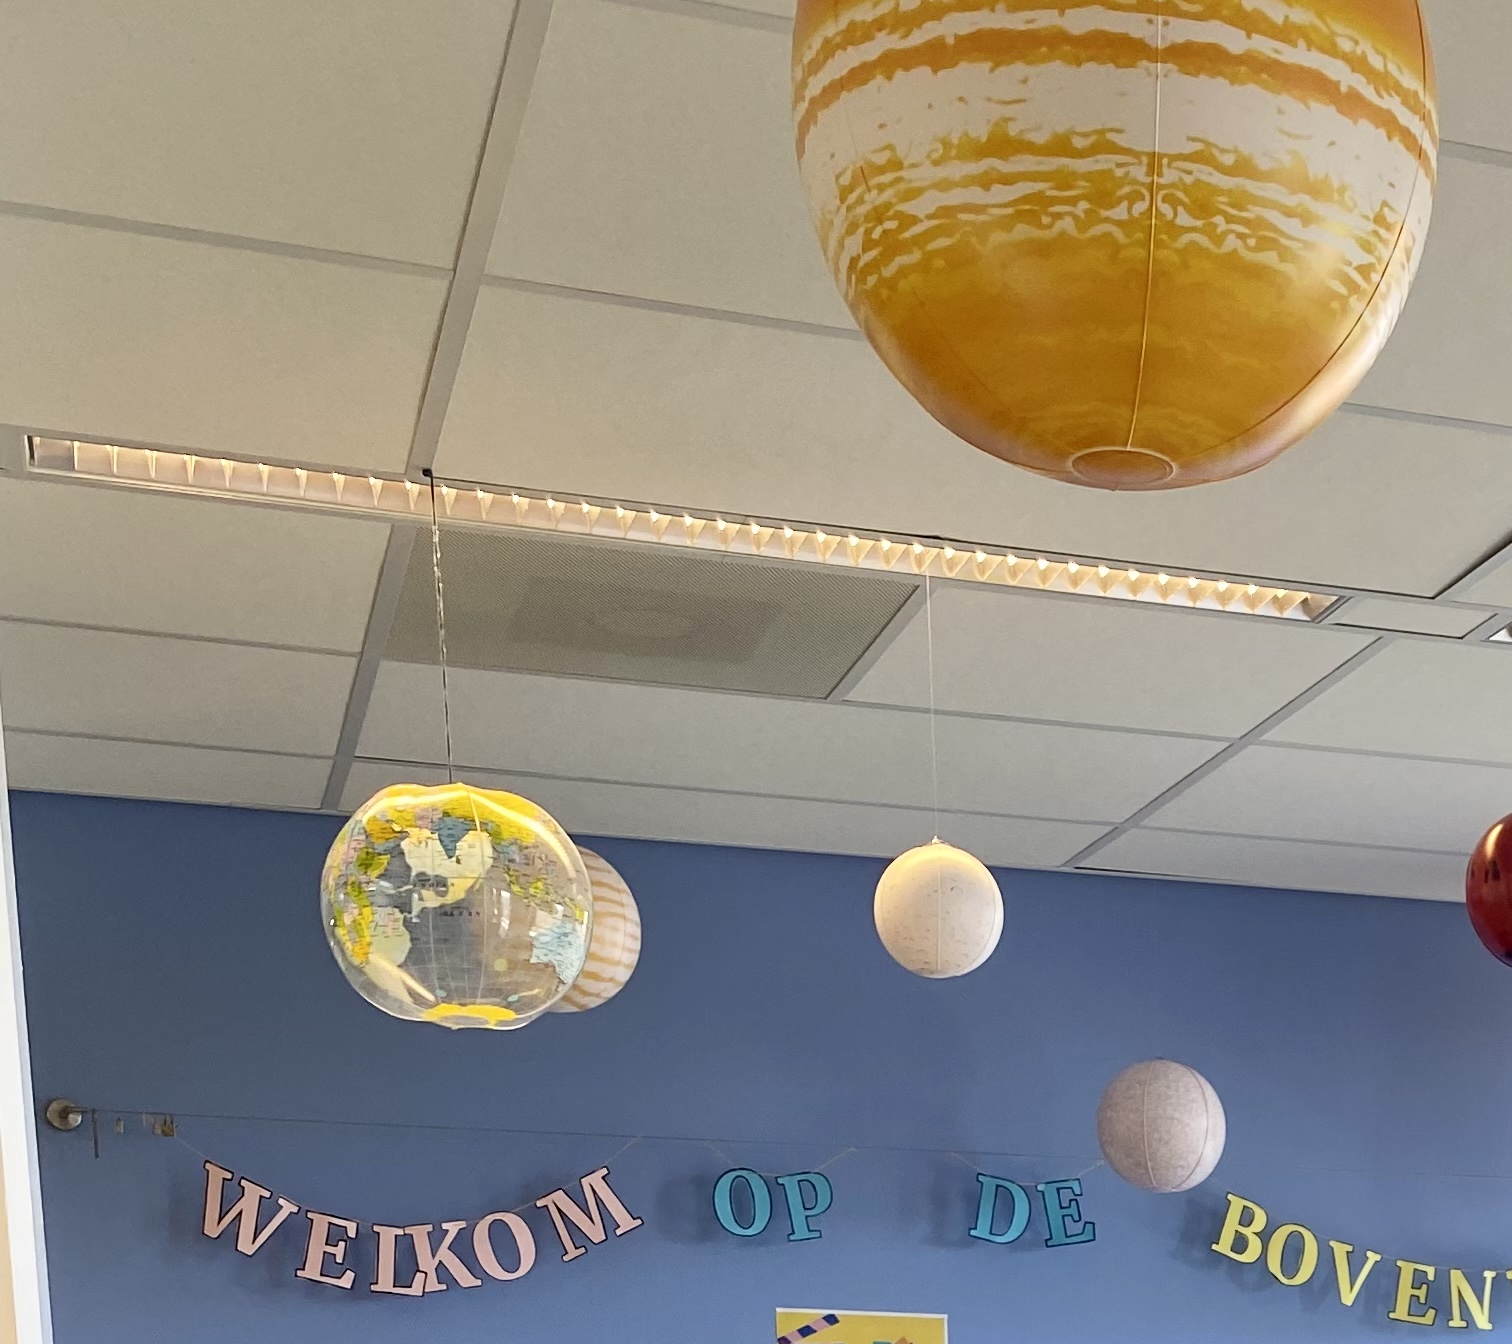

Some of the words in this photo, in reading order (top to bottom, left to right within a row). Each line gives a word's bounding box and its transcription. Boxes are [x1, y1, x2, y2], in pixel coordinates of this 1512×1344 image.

[202, 1160, 644, 1297] WELKOM
[712, 1167, 834, 1242] OP
[968, 1172, 1096, 1247] DE
